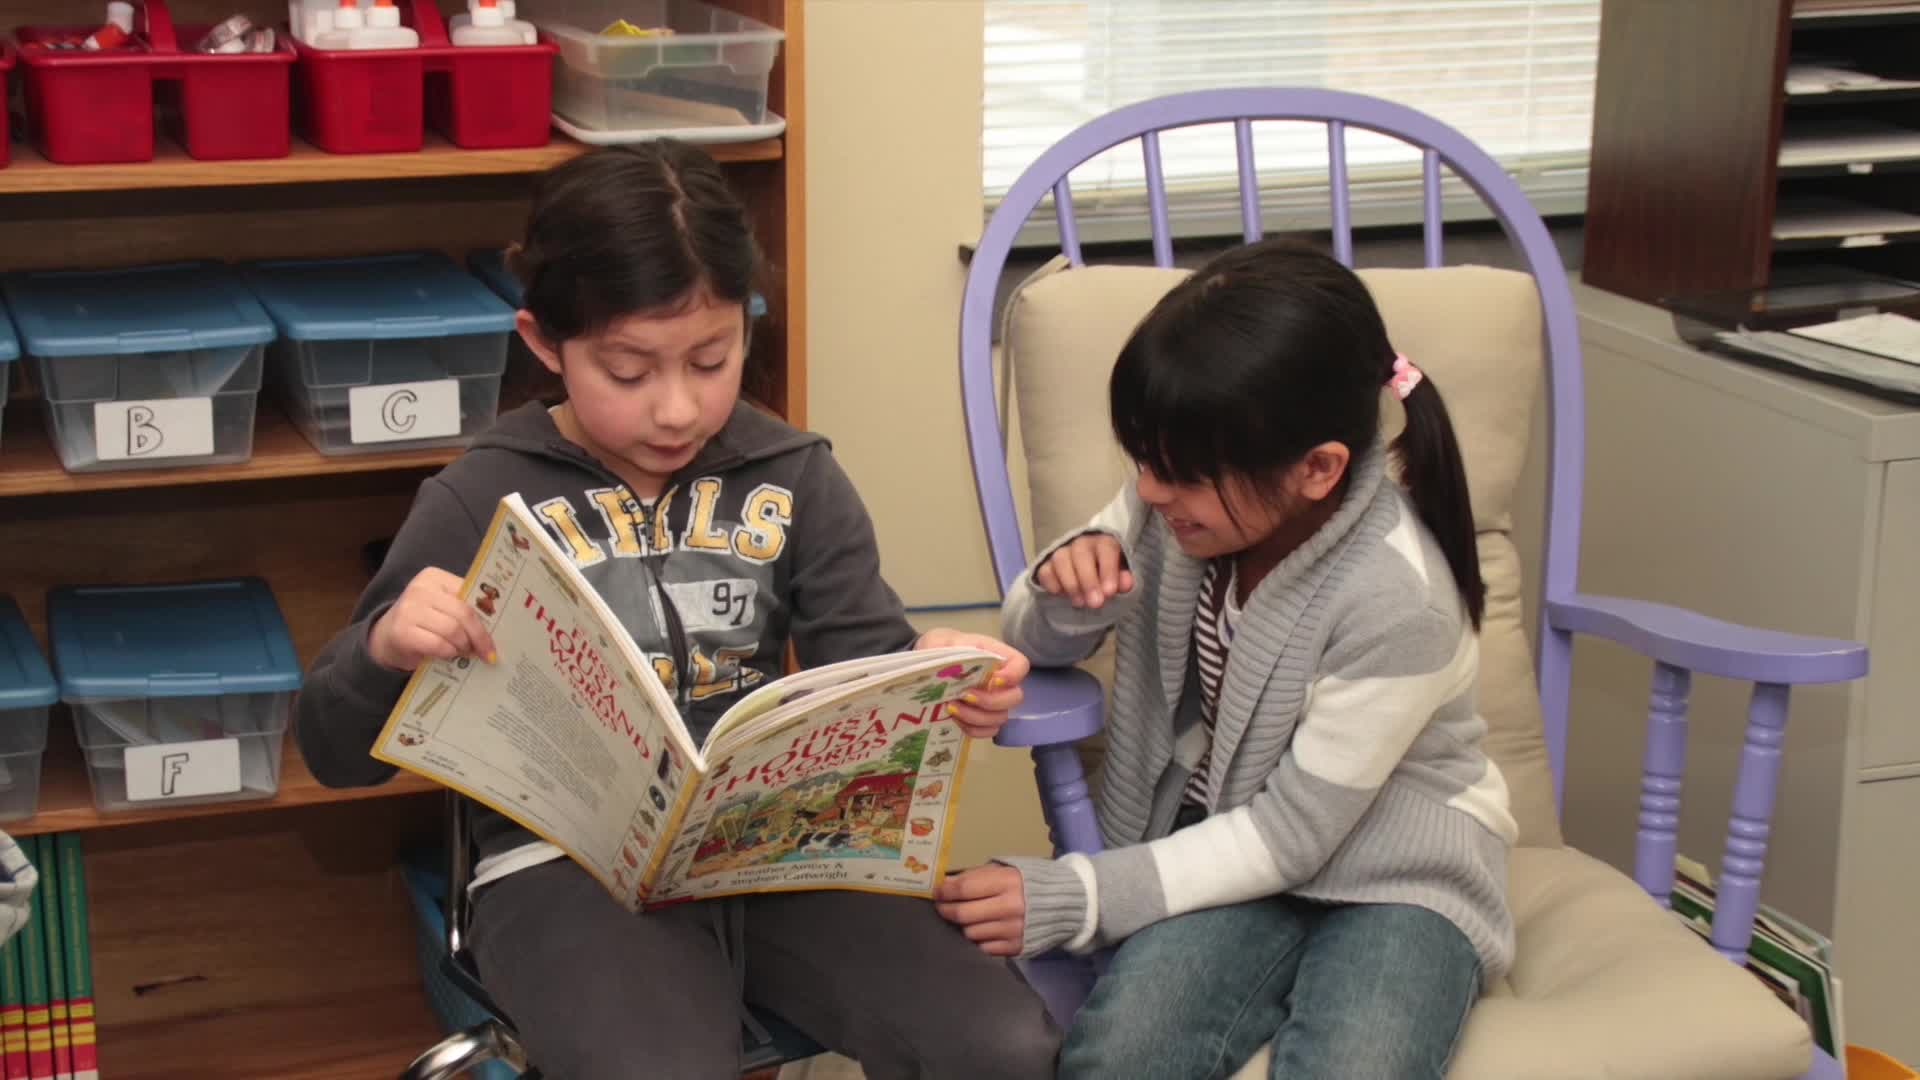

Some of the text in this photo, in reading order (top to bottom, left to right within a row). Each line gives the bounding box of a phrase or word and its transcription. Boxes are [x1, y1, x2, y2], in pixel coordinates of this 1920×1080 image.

[127, 406, 163, 455] B
[382, 390, 419, 433] C
[532, 476, 794, 568] IRLS
[712, 582, 748, 625] 97
[524, 588, 650, 759] THOUSAND
[550, 640, 617, 733] WORDS
[703, 701, 957, 801] THOUSAND
[792, 705, 881, 749] FIRST
[161, 753, 189, 795] F
[763, 735, 888, 785] WORDS
